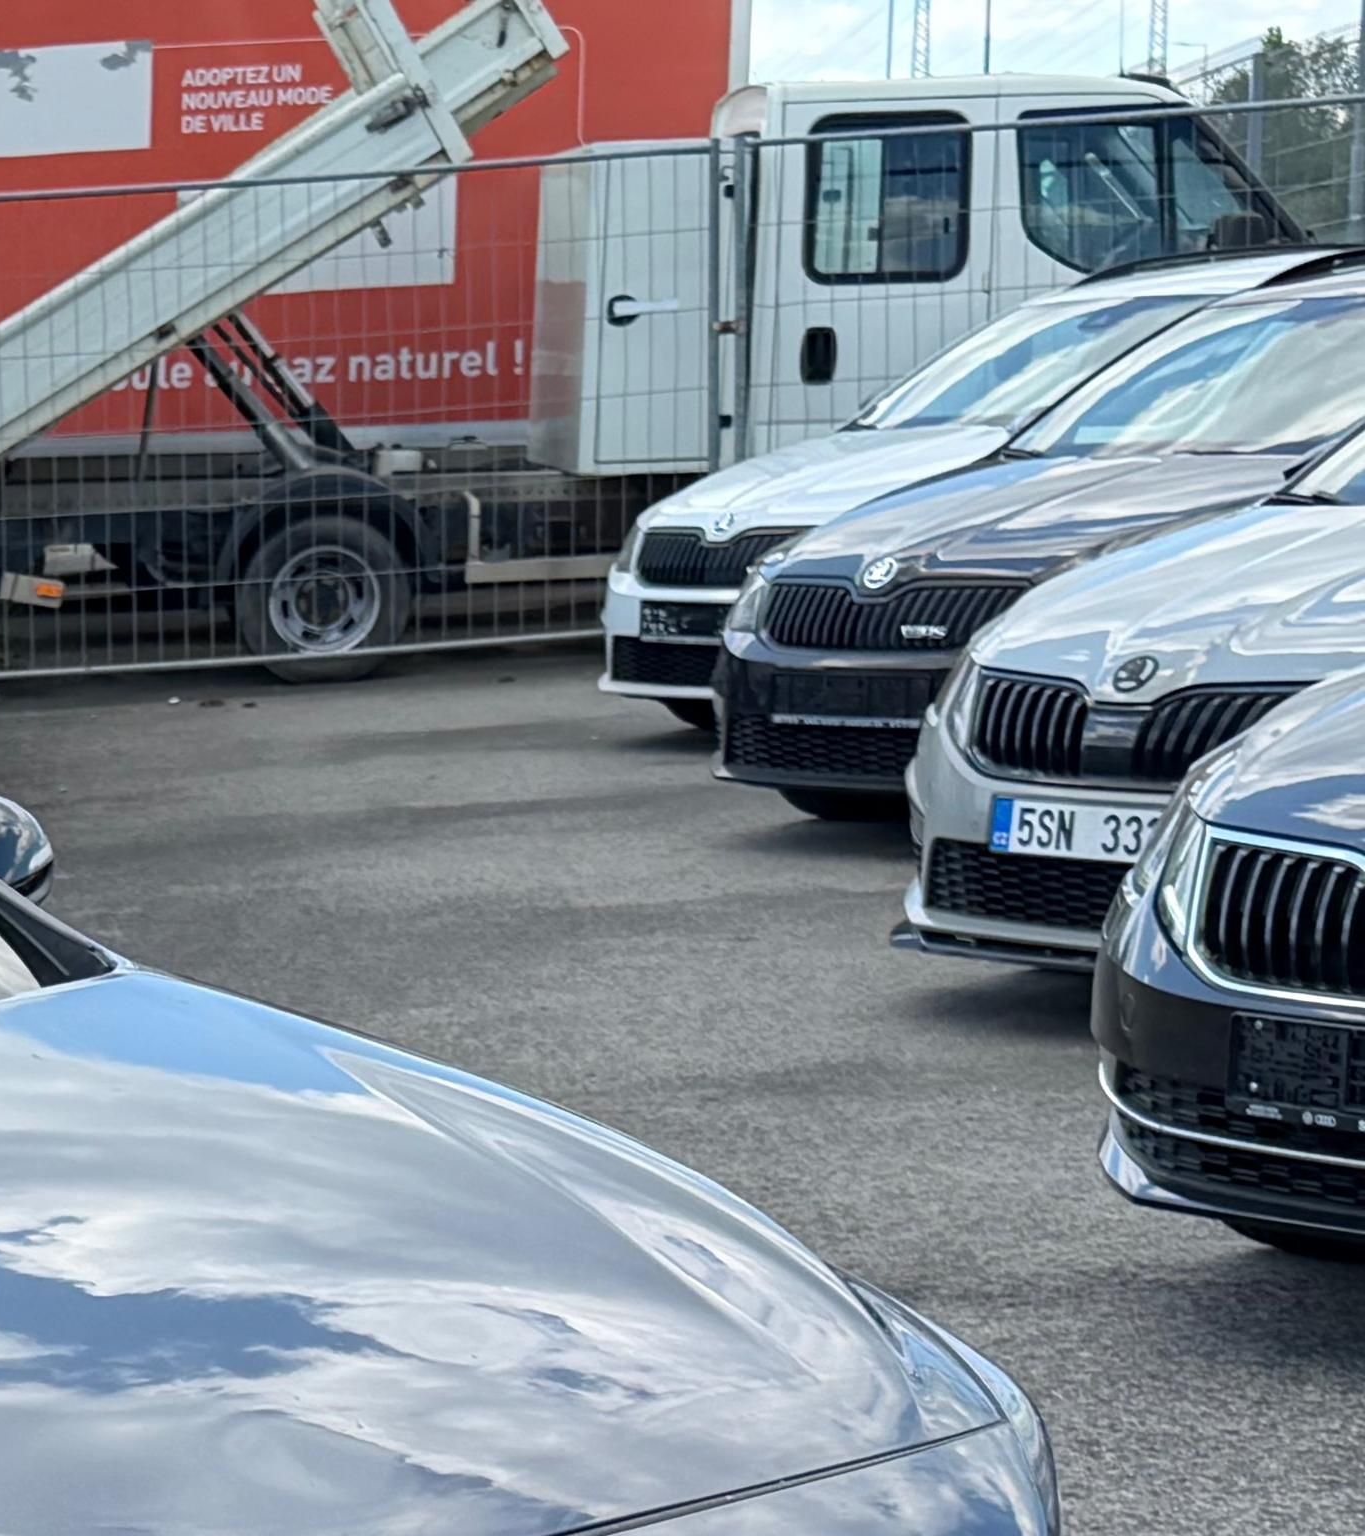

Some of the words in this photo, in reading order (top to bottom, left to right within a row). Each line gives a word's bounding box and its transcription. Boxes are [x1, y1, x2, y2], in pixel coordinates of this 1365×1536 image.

[181, 66, 270, 87] ADOPTEZ
[272, 64, 302, 82] UN
[181, 90, 272, 111] NOUVEAU
[276, 86, 334, 106] MODE
[181, 115, 207, 134] DE
[209, 112, 264, 132] VILLE
[348, 341, 499, 383] naturel
[1018, 807, 1076, 851] 5SN
[1100, 814, 1159, 856] 33
